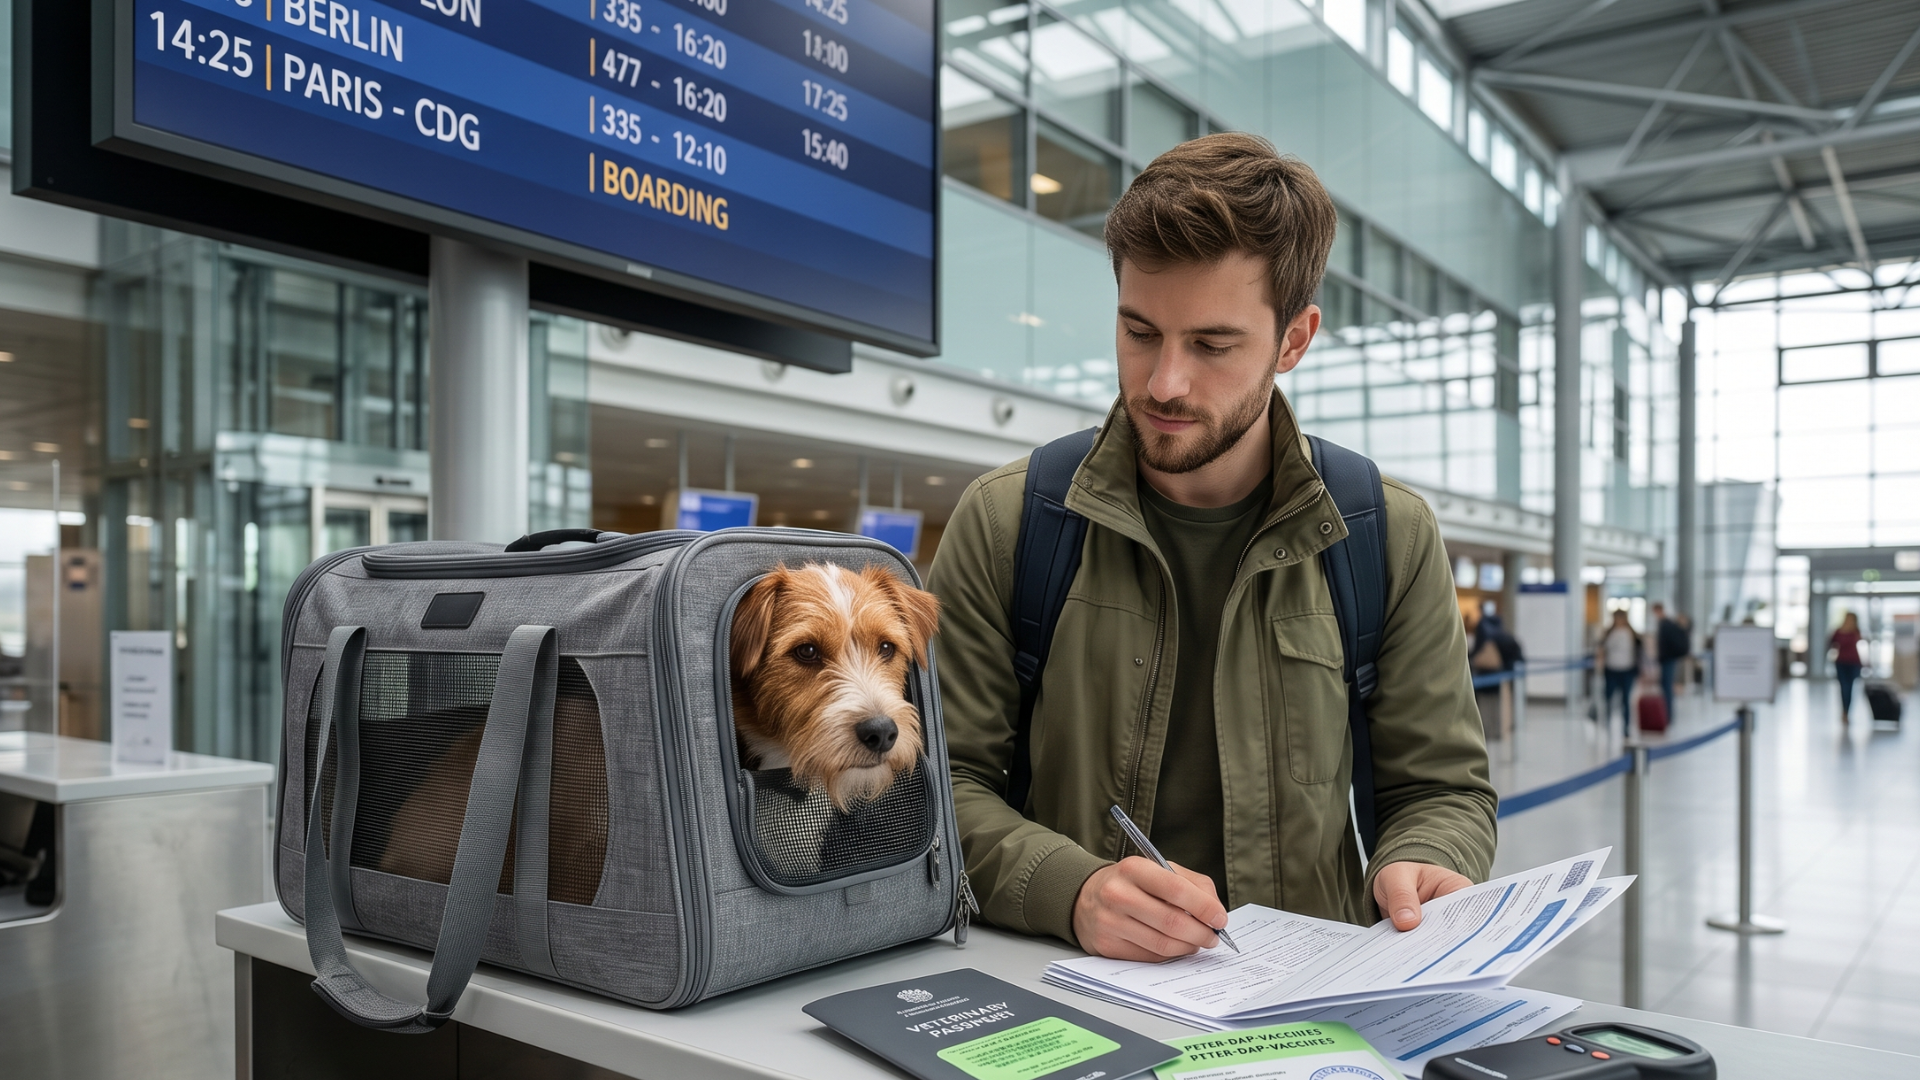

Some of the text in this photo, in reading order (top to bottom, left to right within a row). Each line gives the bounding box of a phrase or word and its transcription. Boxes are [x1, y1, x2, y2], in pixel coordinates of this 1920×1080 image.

[284, 0, 403, 62] BERLIN
[603, 0, 642, 34] 335
[673, 23, 727, 70] 16:20
[150, 11, 253, 78] 14:25
[284, 53, 383, 120] PARIS
[415, 98, 480, 151] CDG
[602, 48, 642, 88] 477
[673, 77, 727, 122] 16:20
[802, 80, 848, 121] 17:25
[602, 104, 642, 145] 335
[673, 131, 727, 175] 12:10
[802, 129, 848, 170] 15:40
[603, 160, 729, 230] BOARDING
